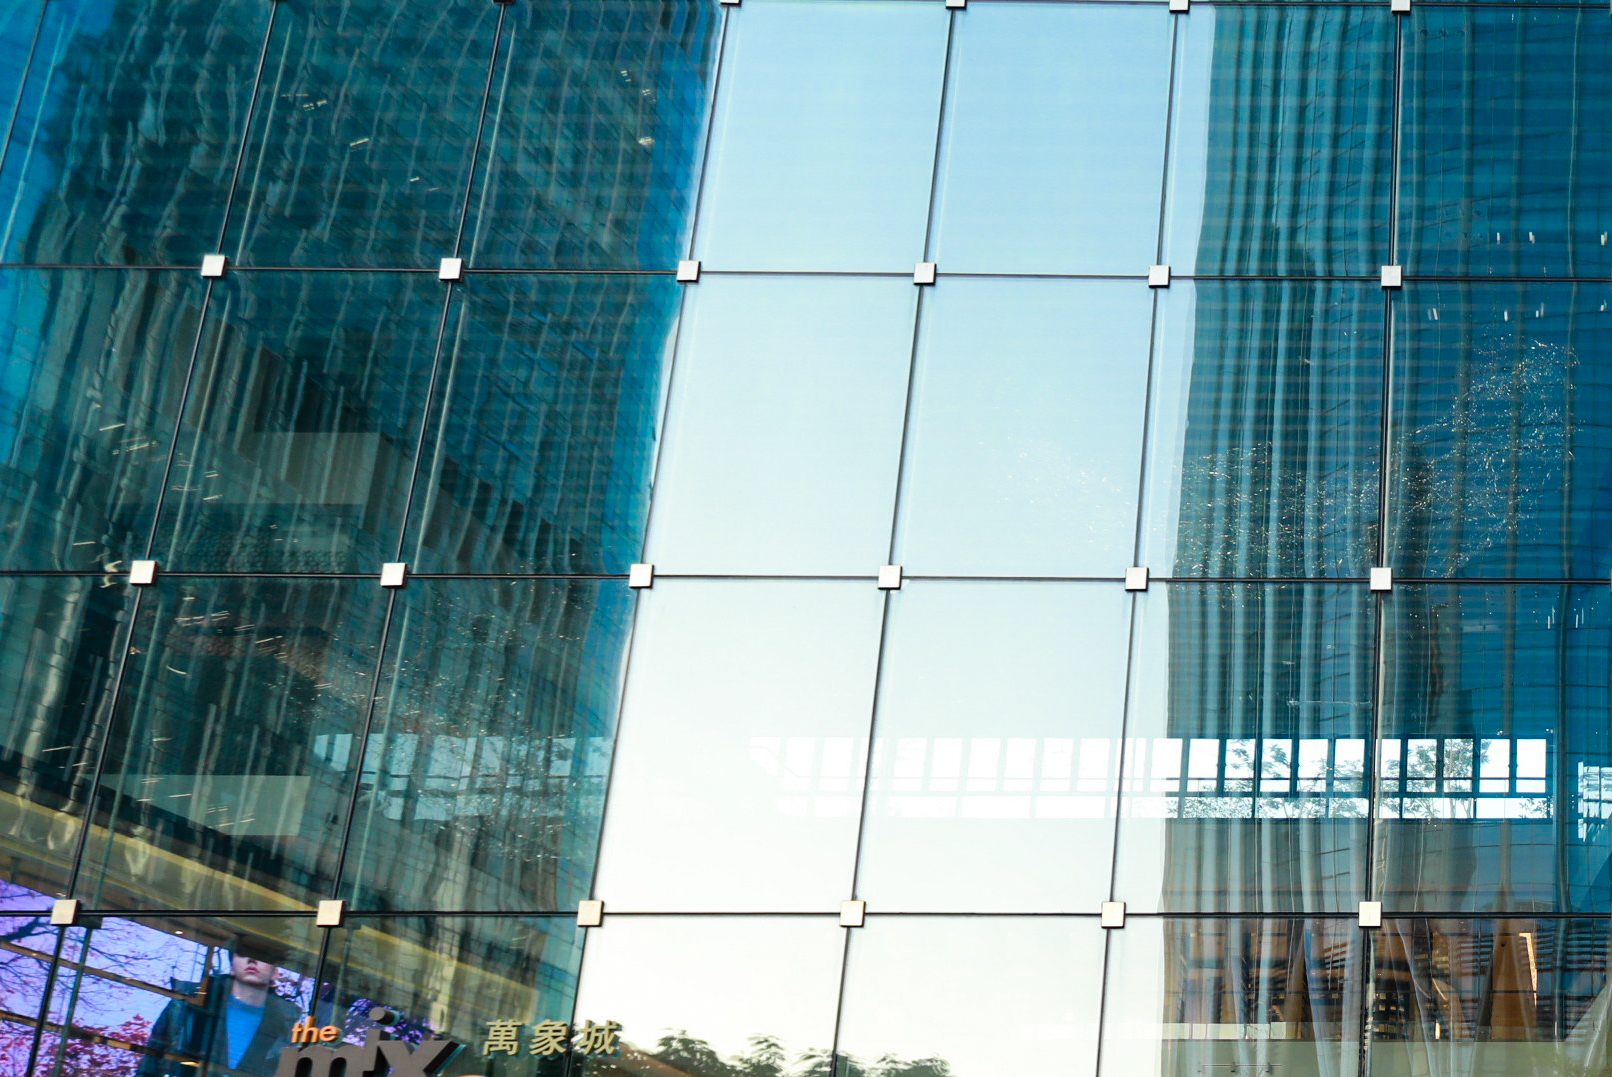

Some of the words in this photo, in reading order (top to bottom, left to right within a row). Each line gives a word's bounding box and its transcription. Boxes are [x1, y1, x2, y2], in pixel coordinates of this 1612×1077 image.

[290, 1015, 339, 1044] the
[482, 1018, 622, 1057] 萬象城
